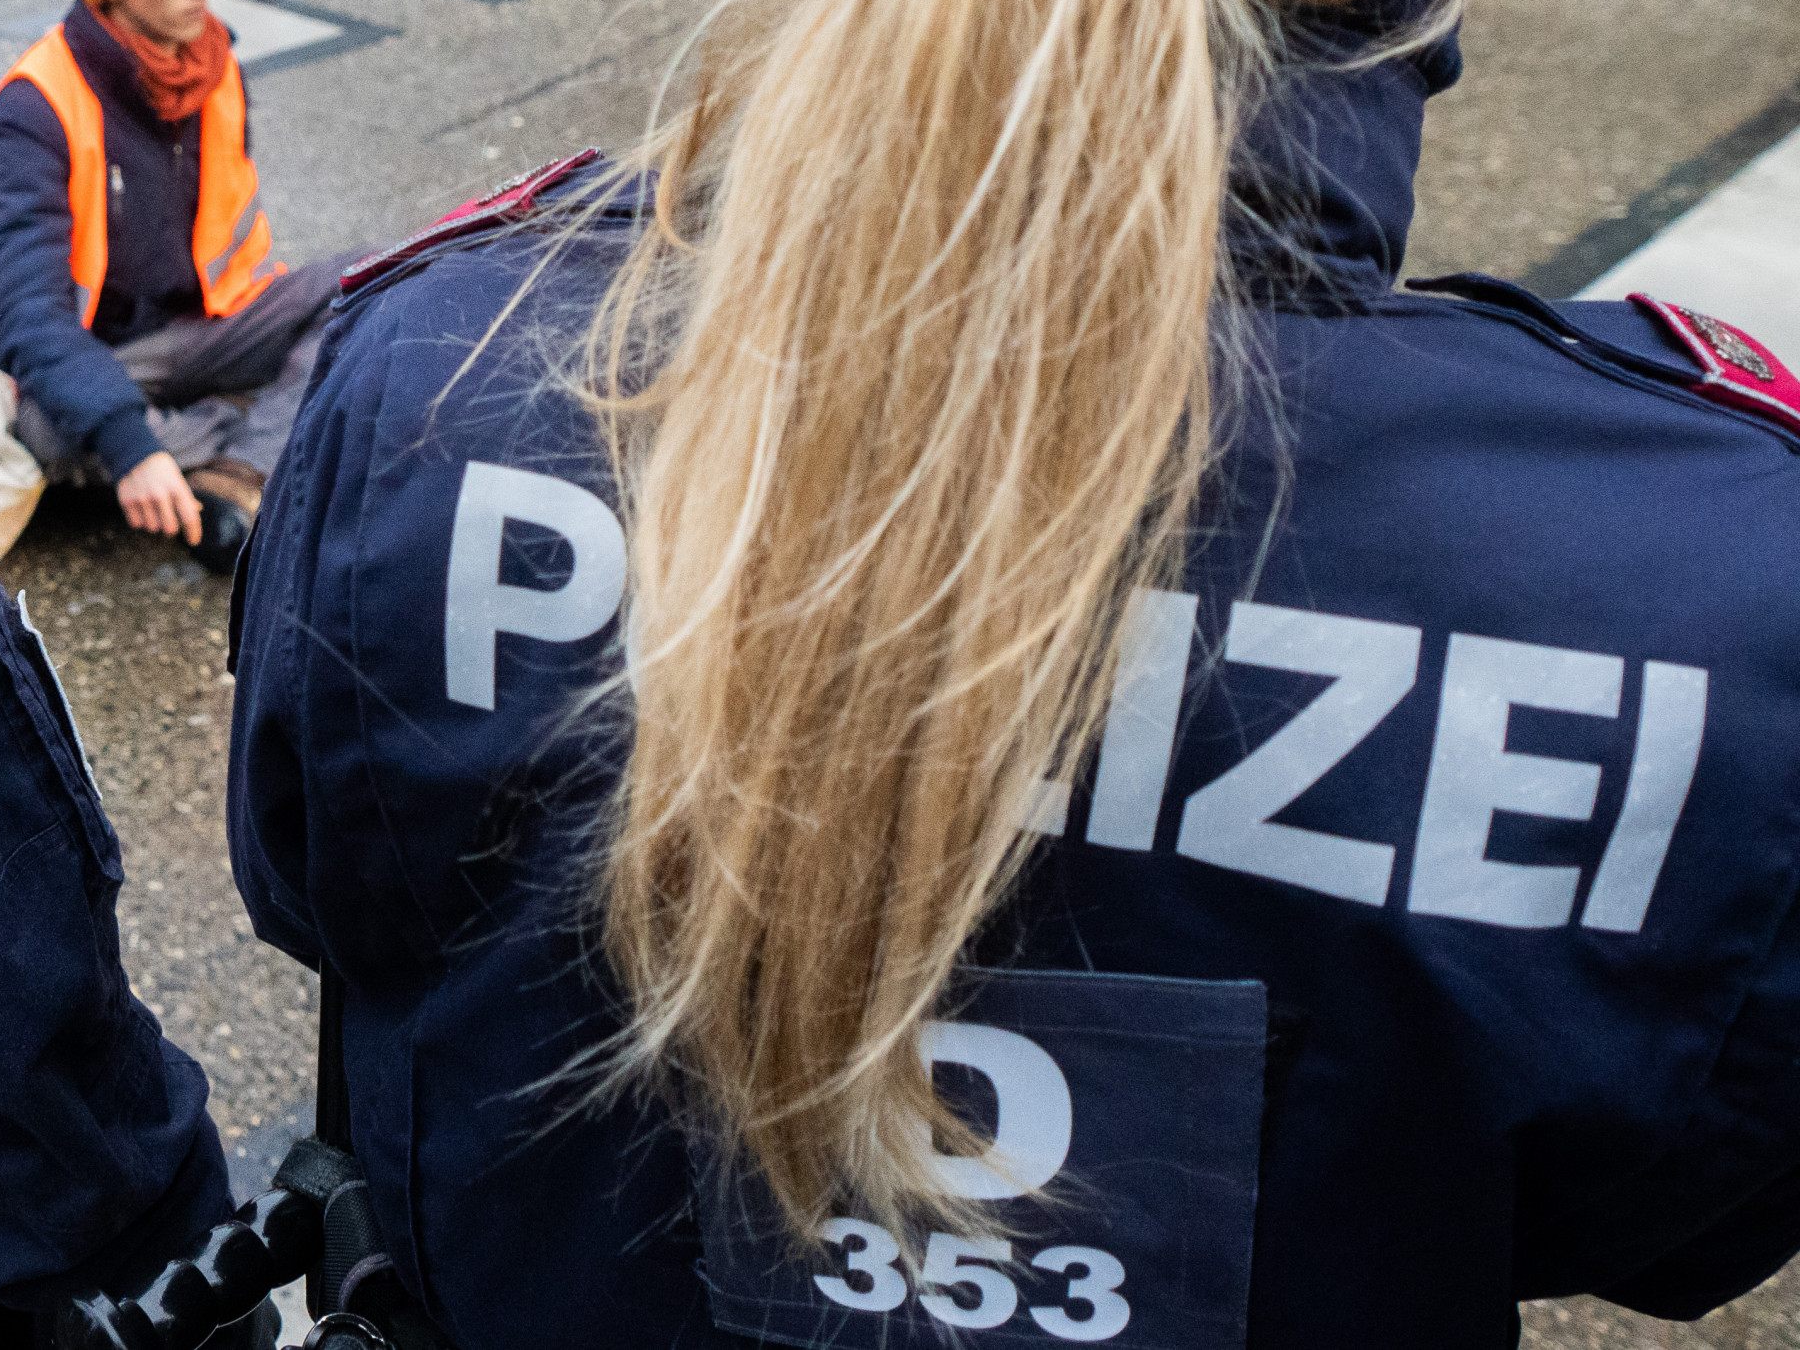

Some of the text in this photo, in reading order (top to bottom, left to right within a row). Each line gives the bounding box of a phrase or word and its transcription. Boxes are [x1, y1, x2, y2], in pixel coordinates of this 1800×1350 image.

[444, 459, 1709, 935] PIZEI
[915, 1020, 1073, 1200] D
[811, 1217, 1131, 1342] 353
